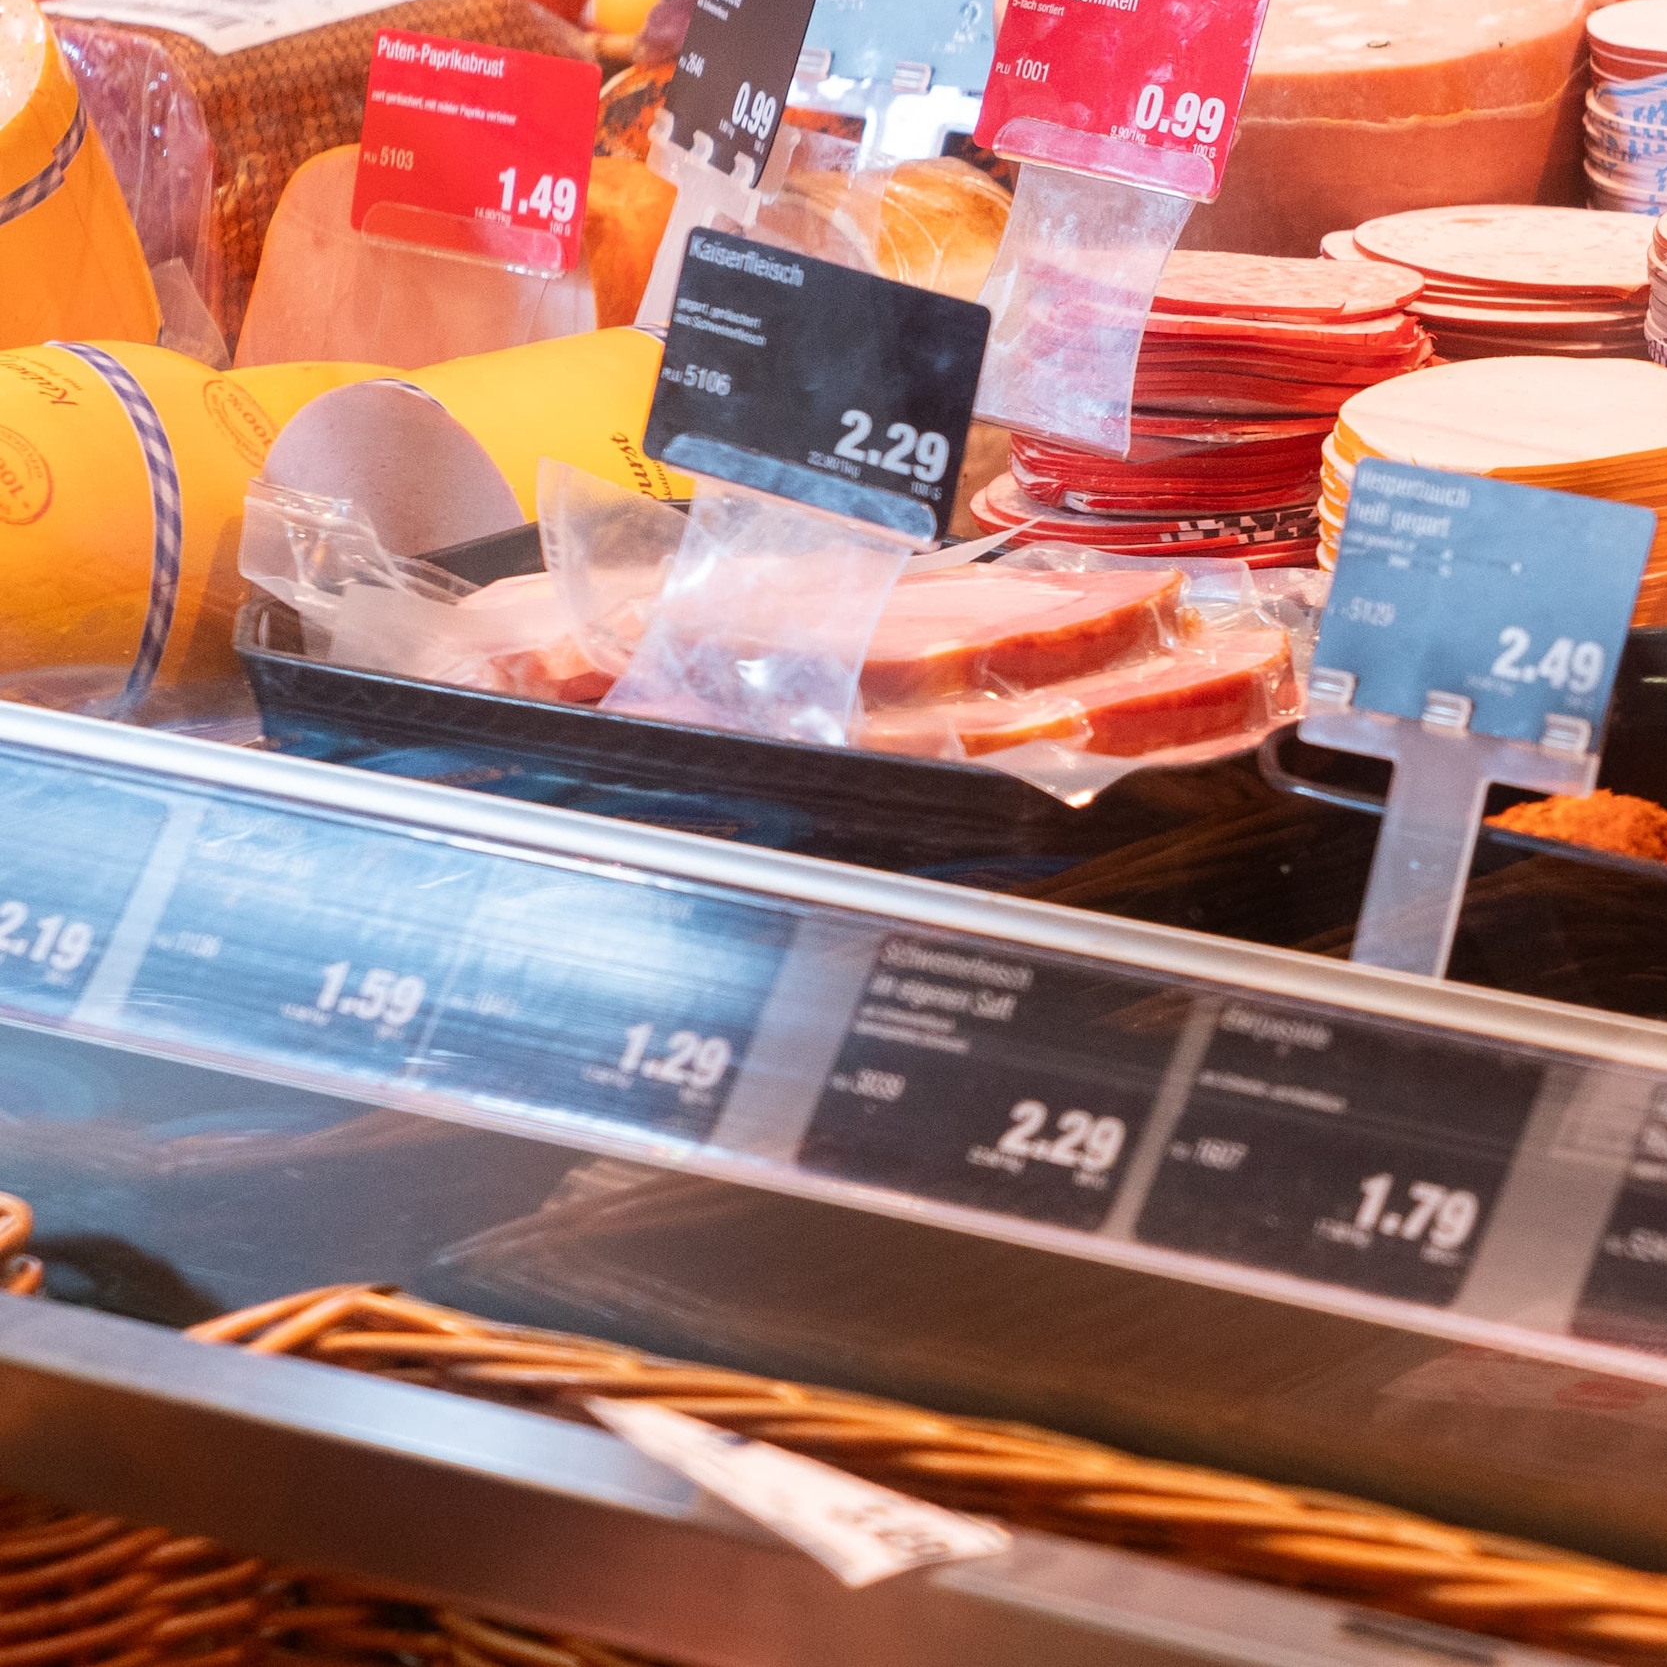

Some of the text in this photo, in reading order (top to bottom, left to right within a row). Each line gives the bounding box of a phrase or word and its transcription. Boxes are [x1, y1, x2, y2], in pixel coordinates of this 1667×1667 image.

[1037, 2, 1064, 16] sortiert
[377, 35, 505, 78] Puten-Paprikabrust
[995, 58, 1050, 82] PLU 1001
[732, 80, 776, 140] 0.99
[1110, 125, 1147, 145] 9.90/1kg
[1135, 84, 1225, 144] 0.99
[380, 146, 414, 171] 5103
[1192, 143, 1209, 158] 100
[499, 167, 577, 222] 1.49
[689, 235, 804, 288] Kaiserfleisch
[683, 363, 732, 397] 5106
[834, 409, 949, 484] 2.29
[1491, 626, 1605, 693] 2.49
[0, 900, 94, 972] 2.19
[316, 960, 427, 1026] 1.59
[618, 1022, 733, 1089] 1.29
[997, 1099, 1127, 1171] 2.29
[1354, 1171, 1480, 1251] 1.79
